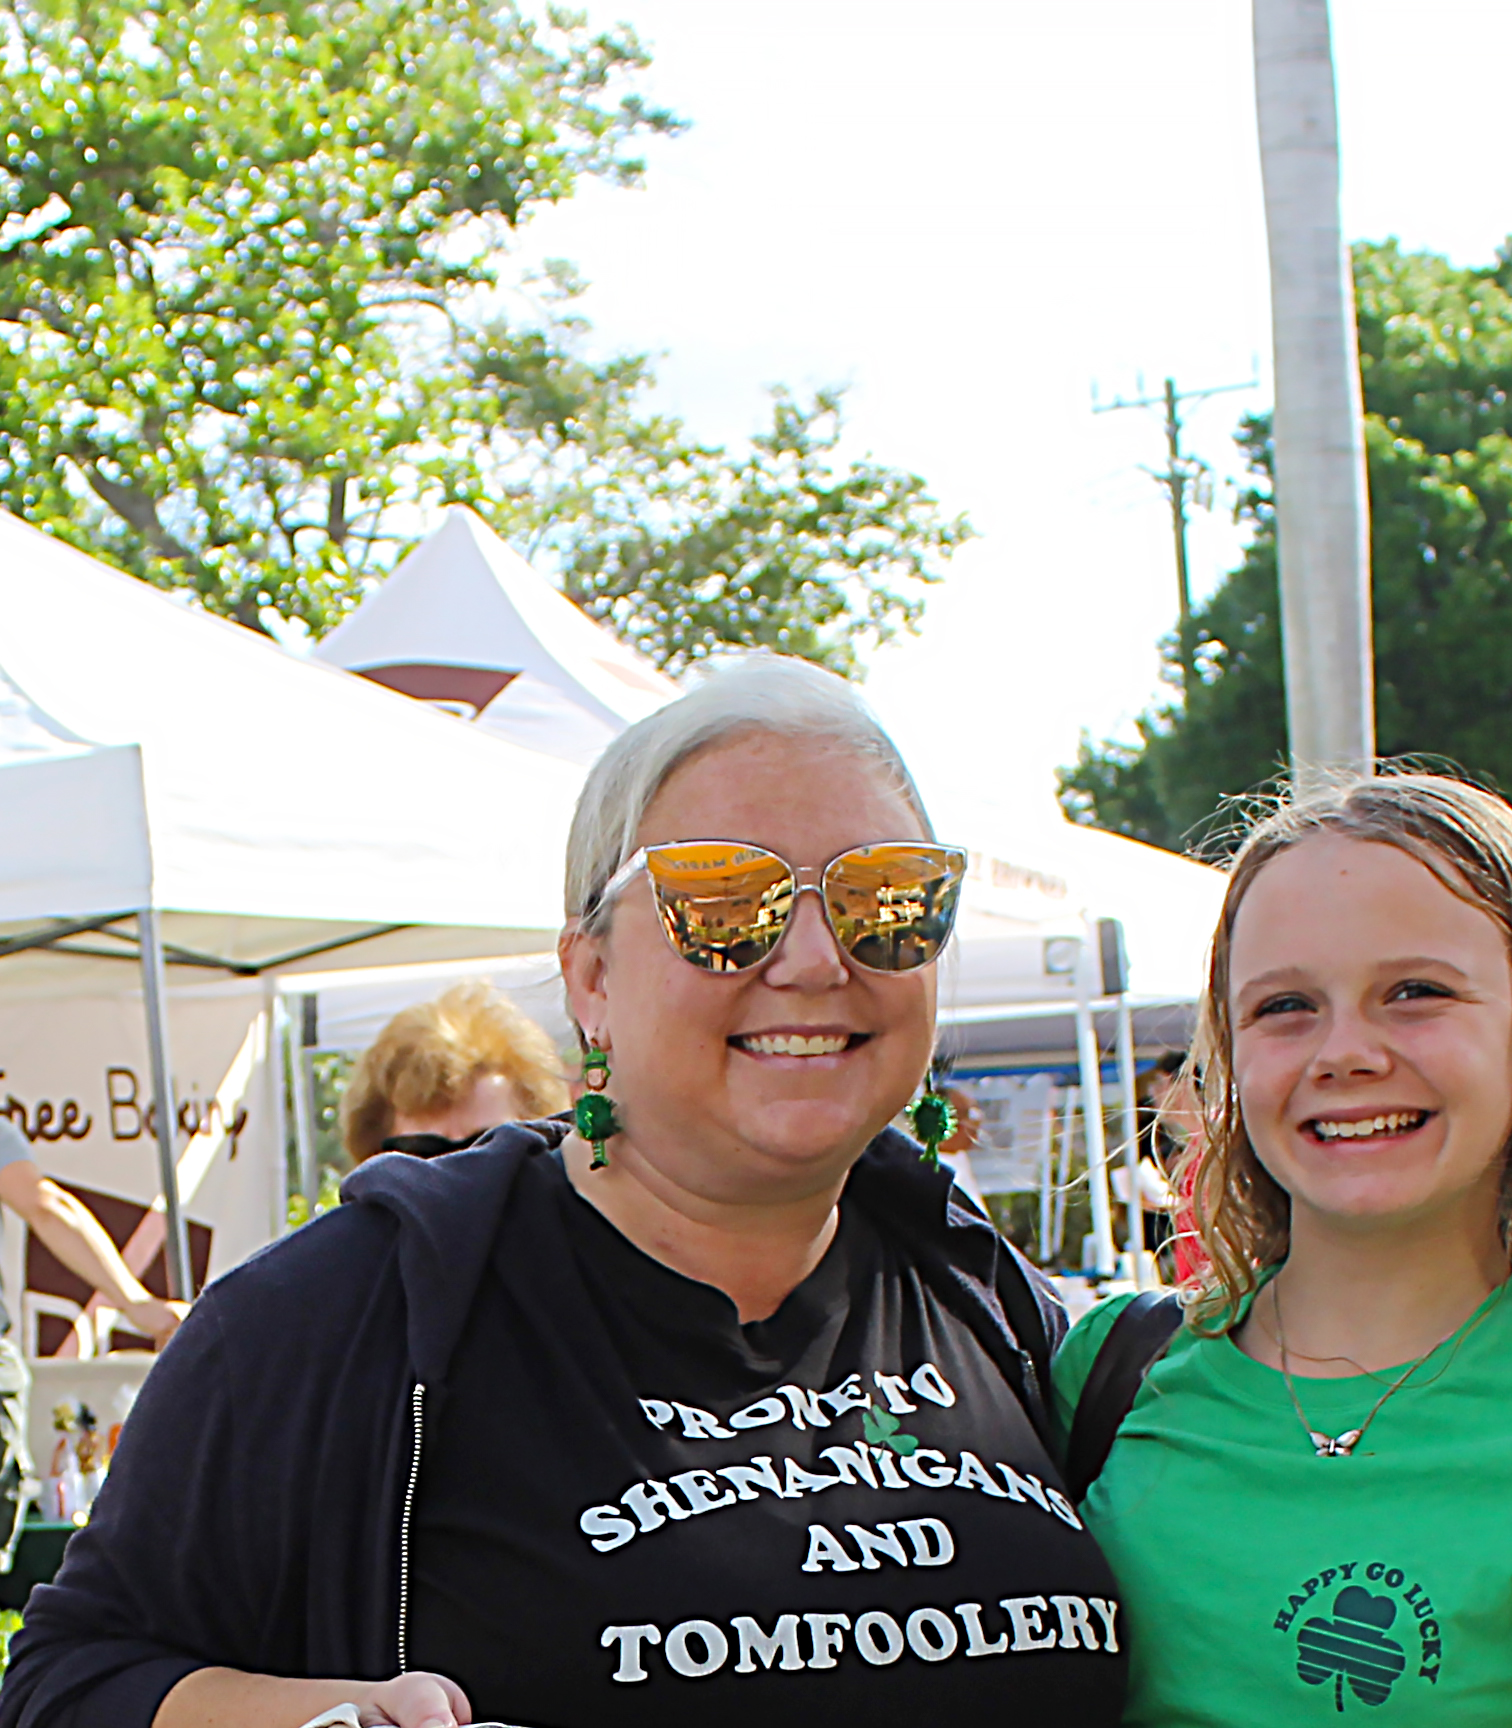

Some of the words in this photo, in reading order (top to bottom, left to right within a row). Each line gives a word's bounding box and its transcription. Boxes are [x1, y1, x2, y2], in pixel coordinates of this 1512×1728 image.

[638, 1373, 872, 1440] PRONE
[874, 1362, 956, 1416] TO
[579, 1440, 1085, 1554] SHENANIGANS
[801, 1516, 956, 1573] AND
[600, 1594, 1120, 1683] TOMFOOLERY
[1273, 1561, 1359, 1634] HAPPY
[1365, 1561, 1405, 1589] GO
[1402, 1582, 1442, 1685] LUCKY
